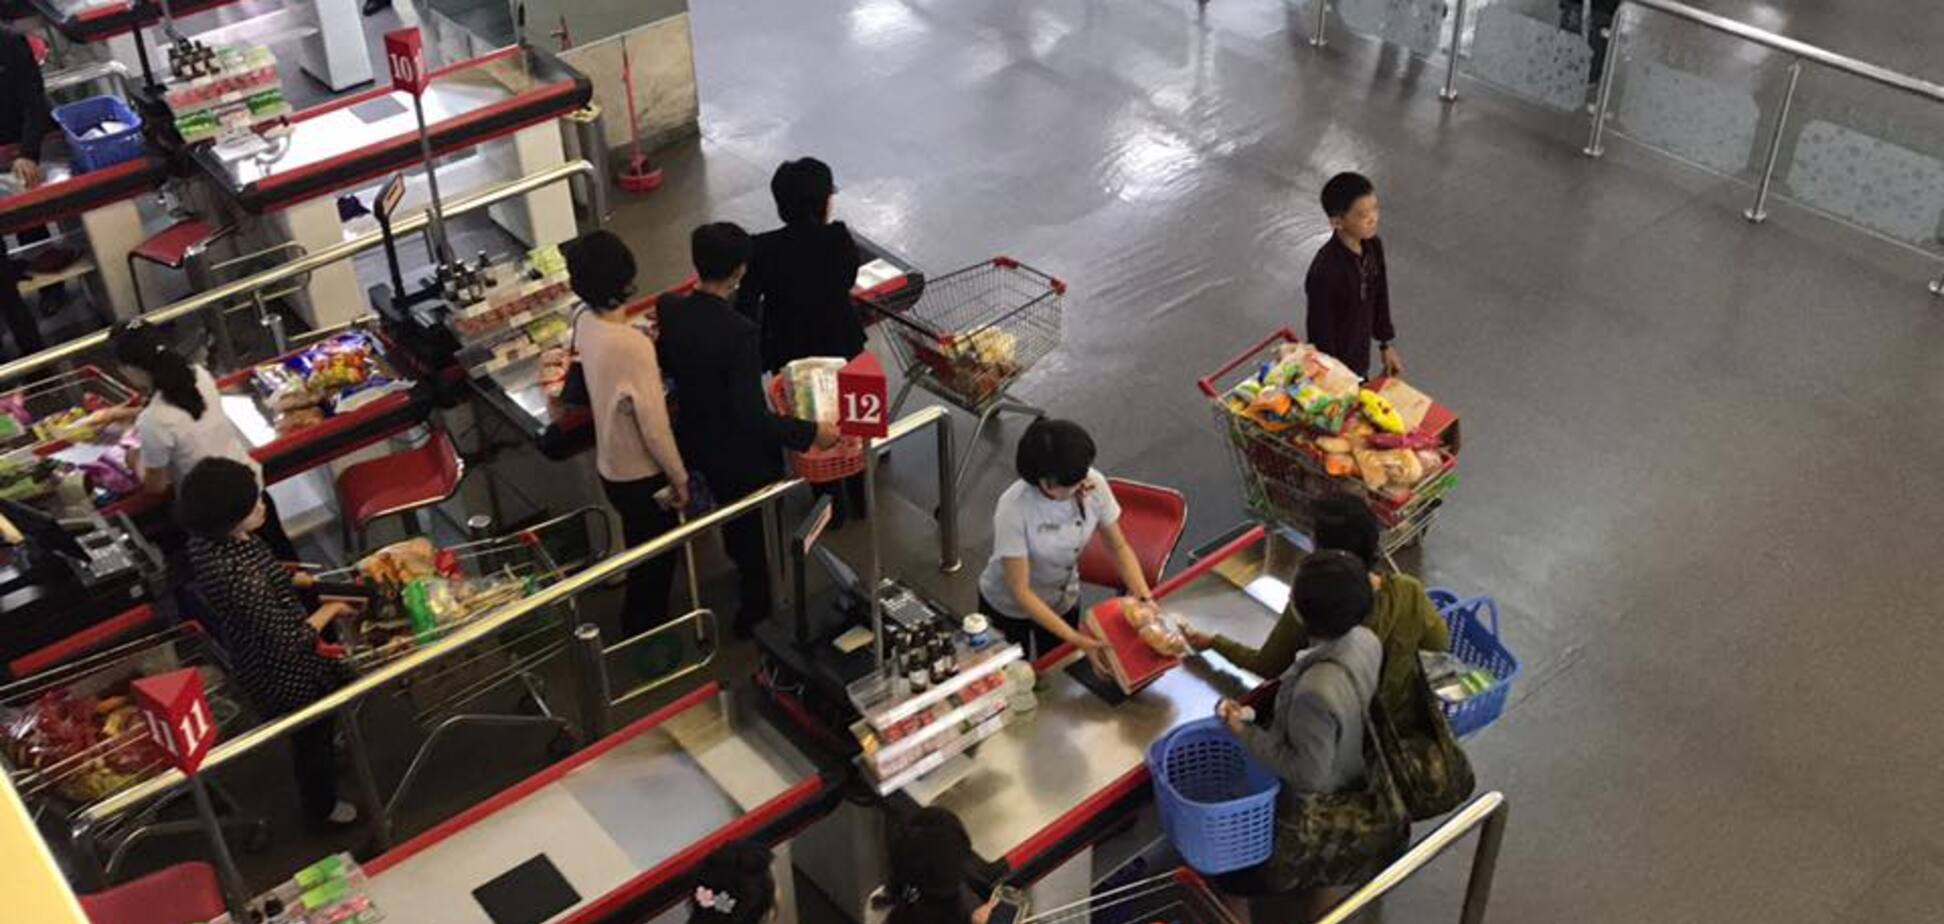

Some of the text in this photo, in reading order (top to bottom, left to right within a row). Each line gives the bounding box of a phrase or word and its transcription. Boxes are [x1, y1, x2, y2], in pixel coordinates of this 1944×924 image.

[390, 53, 413, 82] 10
[842, 391, 880, 424] 12
[179, 698, 210, 757] 11
